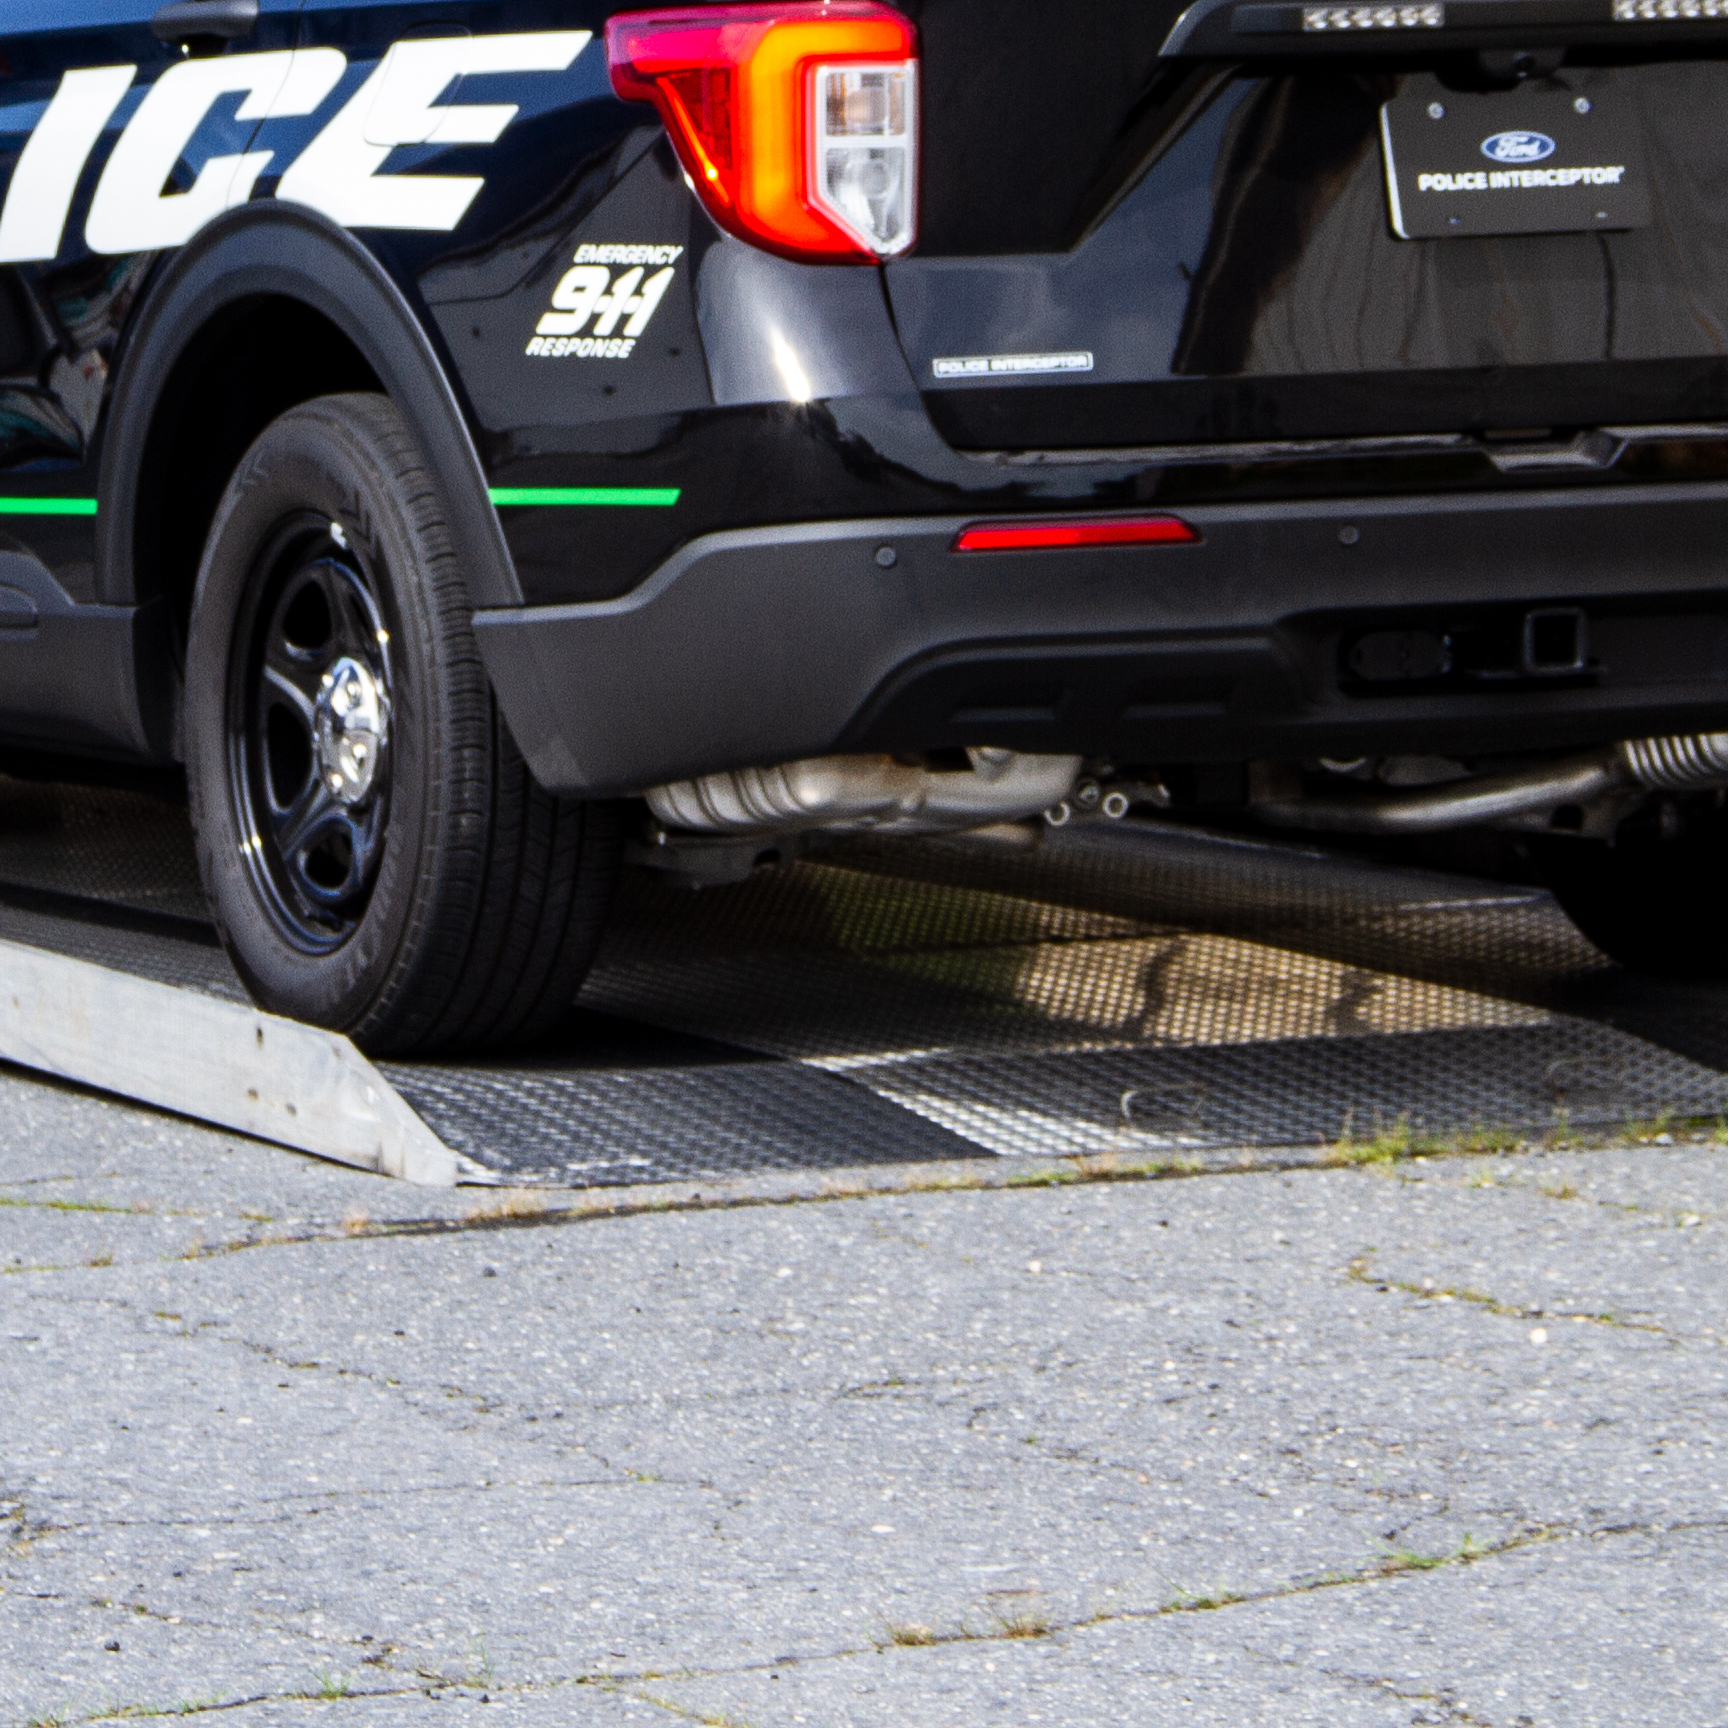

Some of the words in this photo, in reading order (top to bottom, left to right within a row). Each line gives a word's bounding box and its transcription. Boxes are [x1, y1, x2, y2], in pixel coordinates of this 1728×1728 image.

[1418, 171, 1488, 192] POLICE
[1489, 165, 1625, 189] INTERCEPTOR
[573, 243, 684, 265] EMERGENCY
[525, 336, 636, 359] RESPONSE
